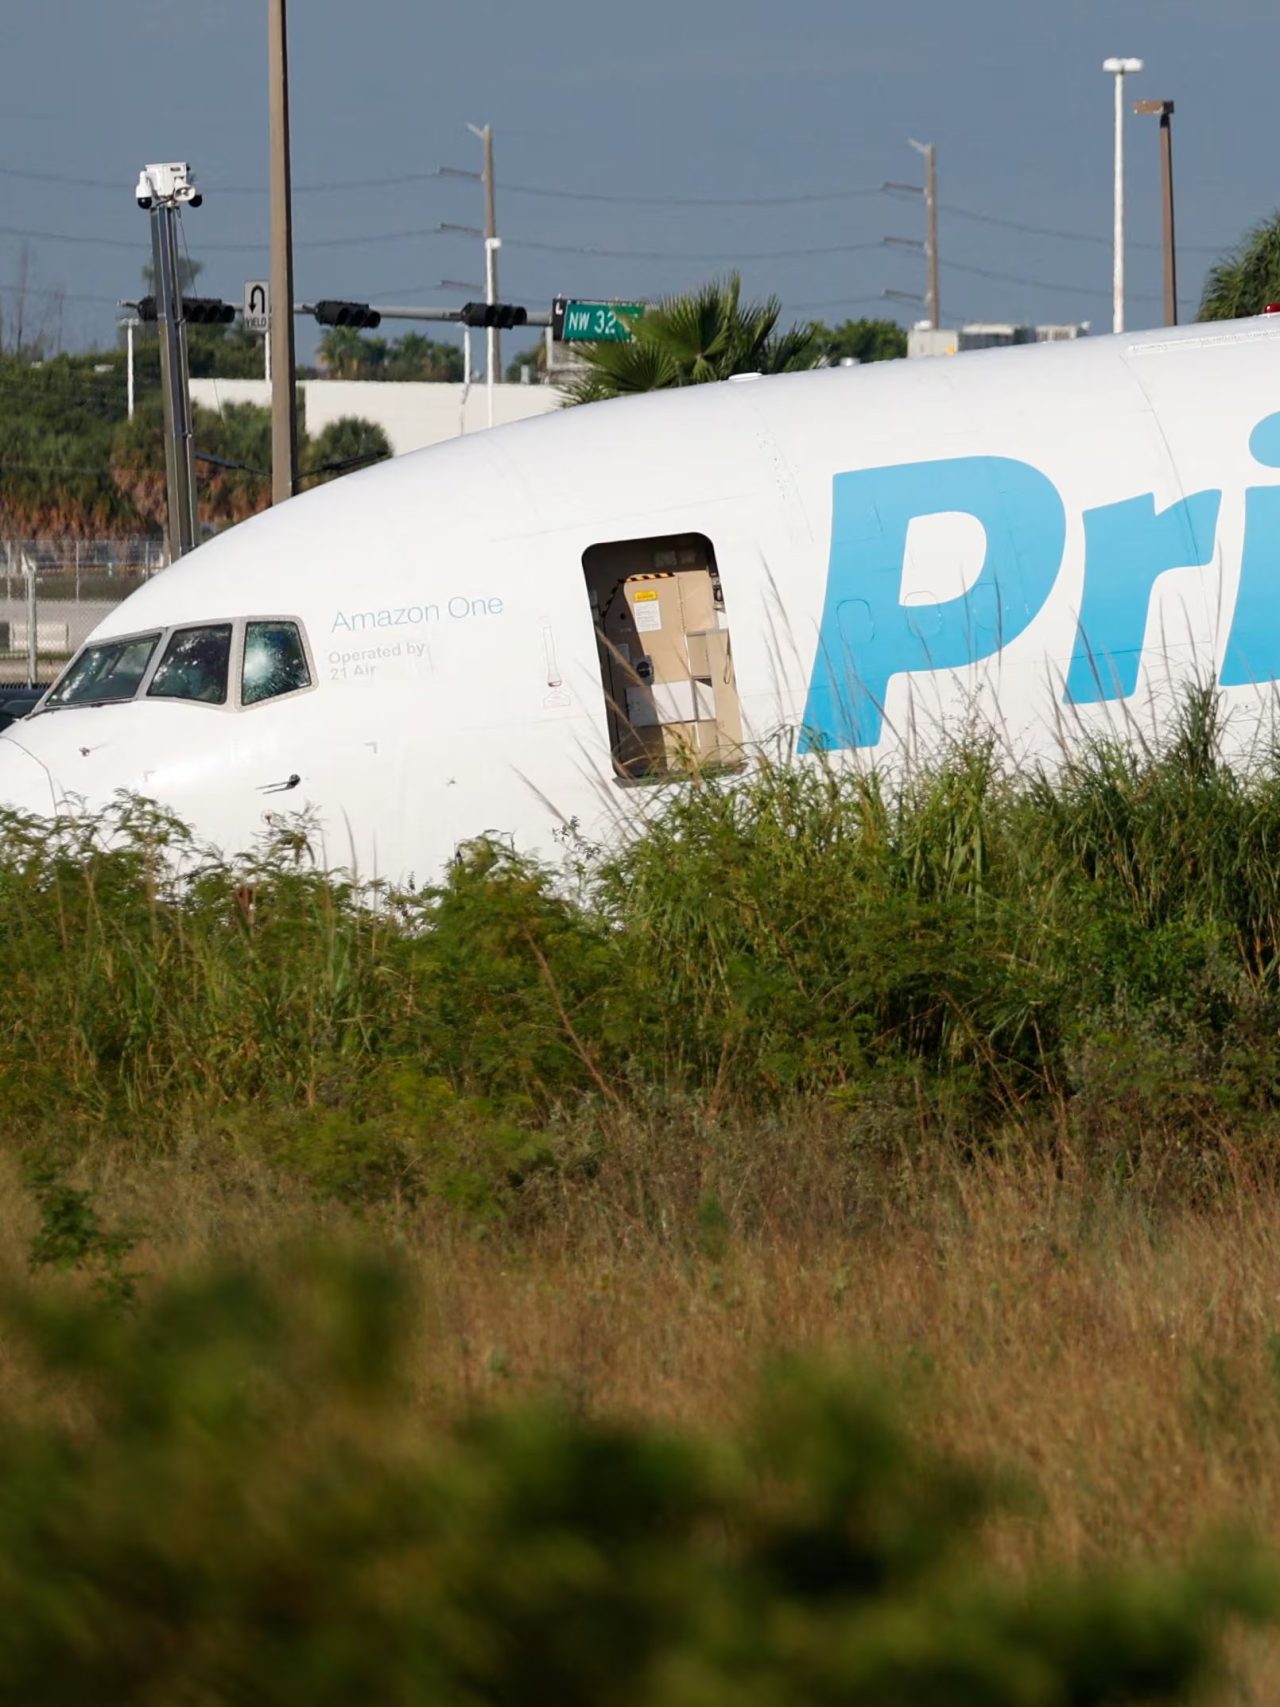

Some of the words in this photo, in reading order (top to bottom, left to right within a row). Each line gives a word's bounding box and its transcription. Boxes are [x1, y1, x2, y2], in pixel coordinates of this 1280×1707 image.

[246, 317, 267, 328] YIELD
[569, 312, 590, 331] NW
[594, 310, 616, 334] 32
[331, 603, 440, 633] Amazon
[448, 596, 504, 619] One
[328, 643, 401, 666] Operated
[406, 642, 425, 657] by
[330, 667, 347, 681] 21
[354, 665, 377, 677] Air
